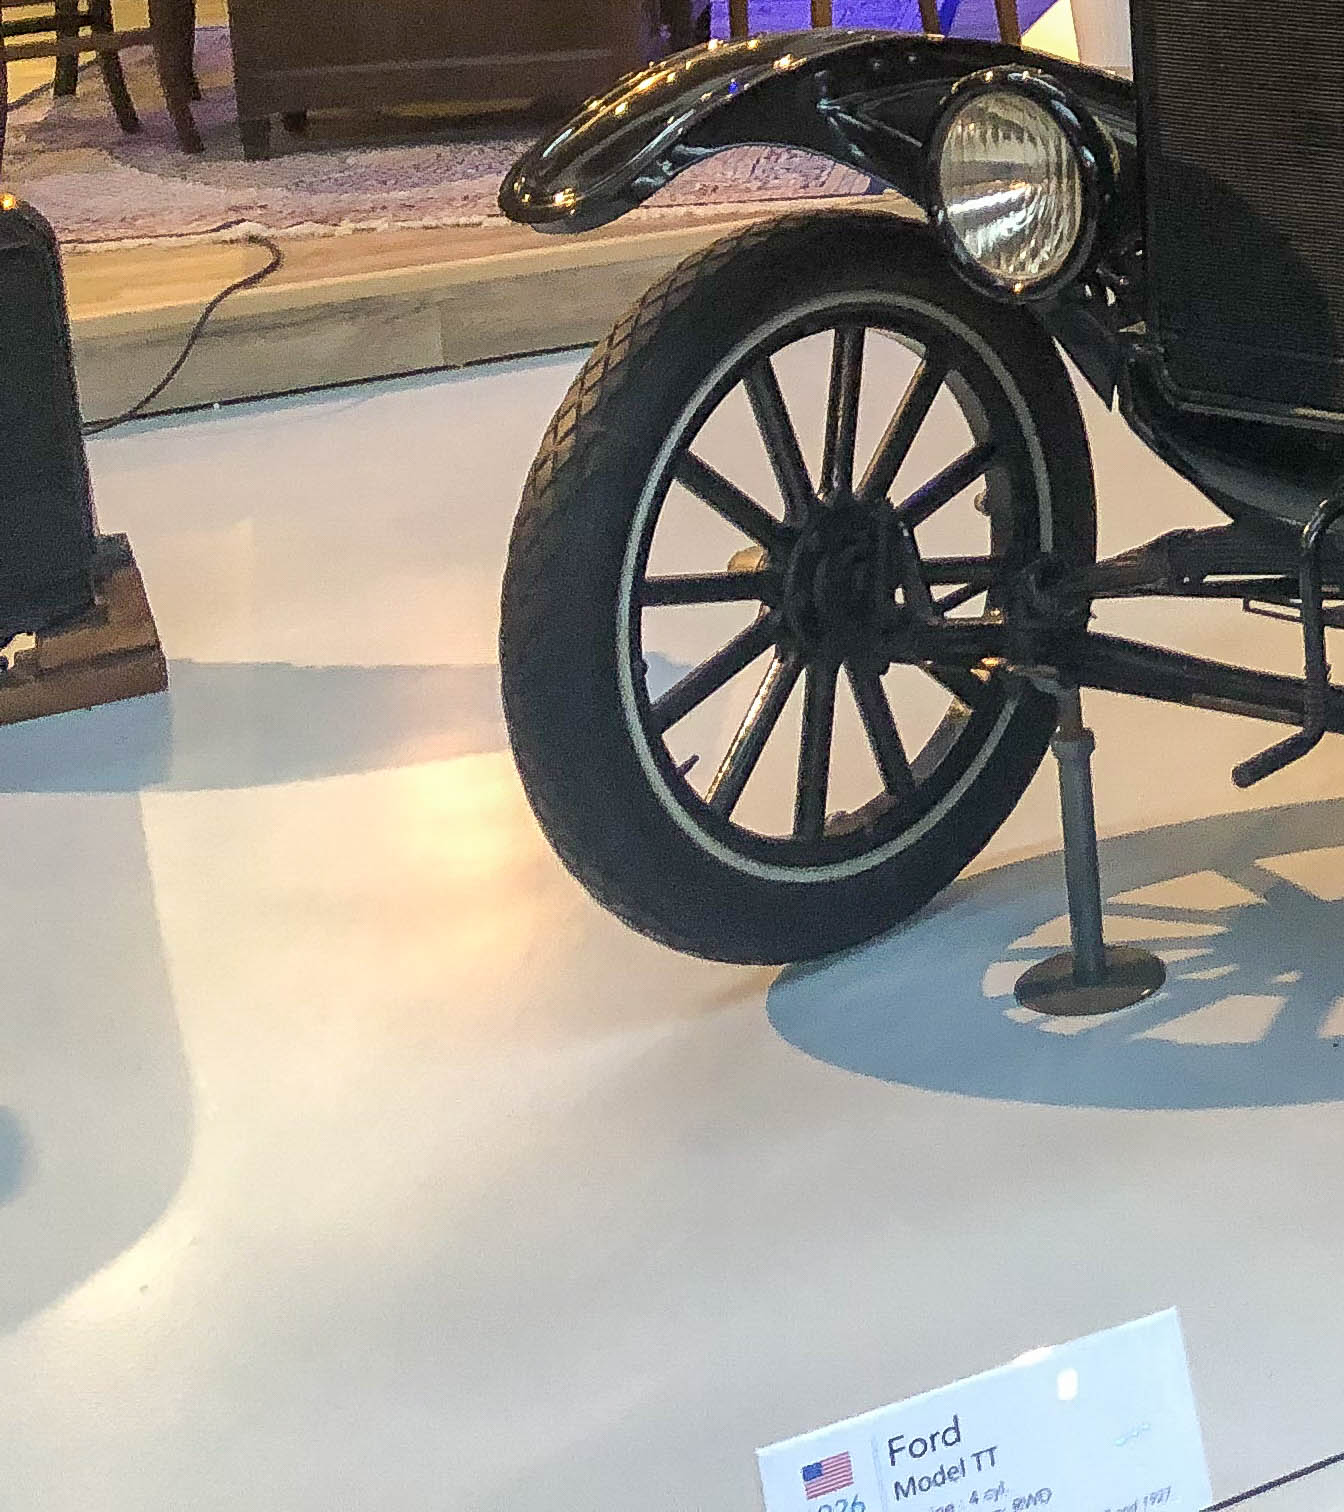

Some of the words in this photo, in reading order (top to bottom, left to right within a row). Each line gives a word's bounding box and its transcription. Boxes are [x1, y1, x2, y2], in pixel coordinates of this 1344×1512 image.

[888, 1414, 961, 1467] Ford
[894, 1456, 965, 1501] Model
[970, 1445, 998, 1472] TT
